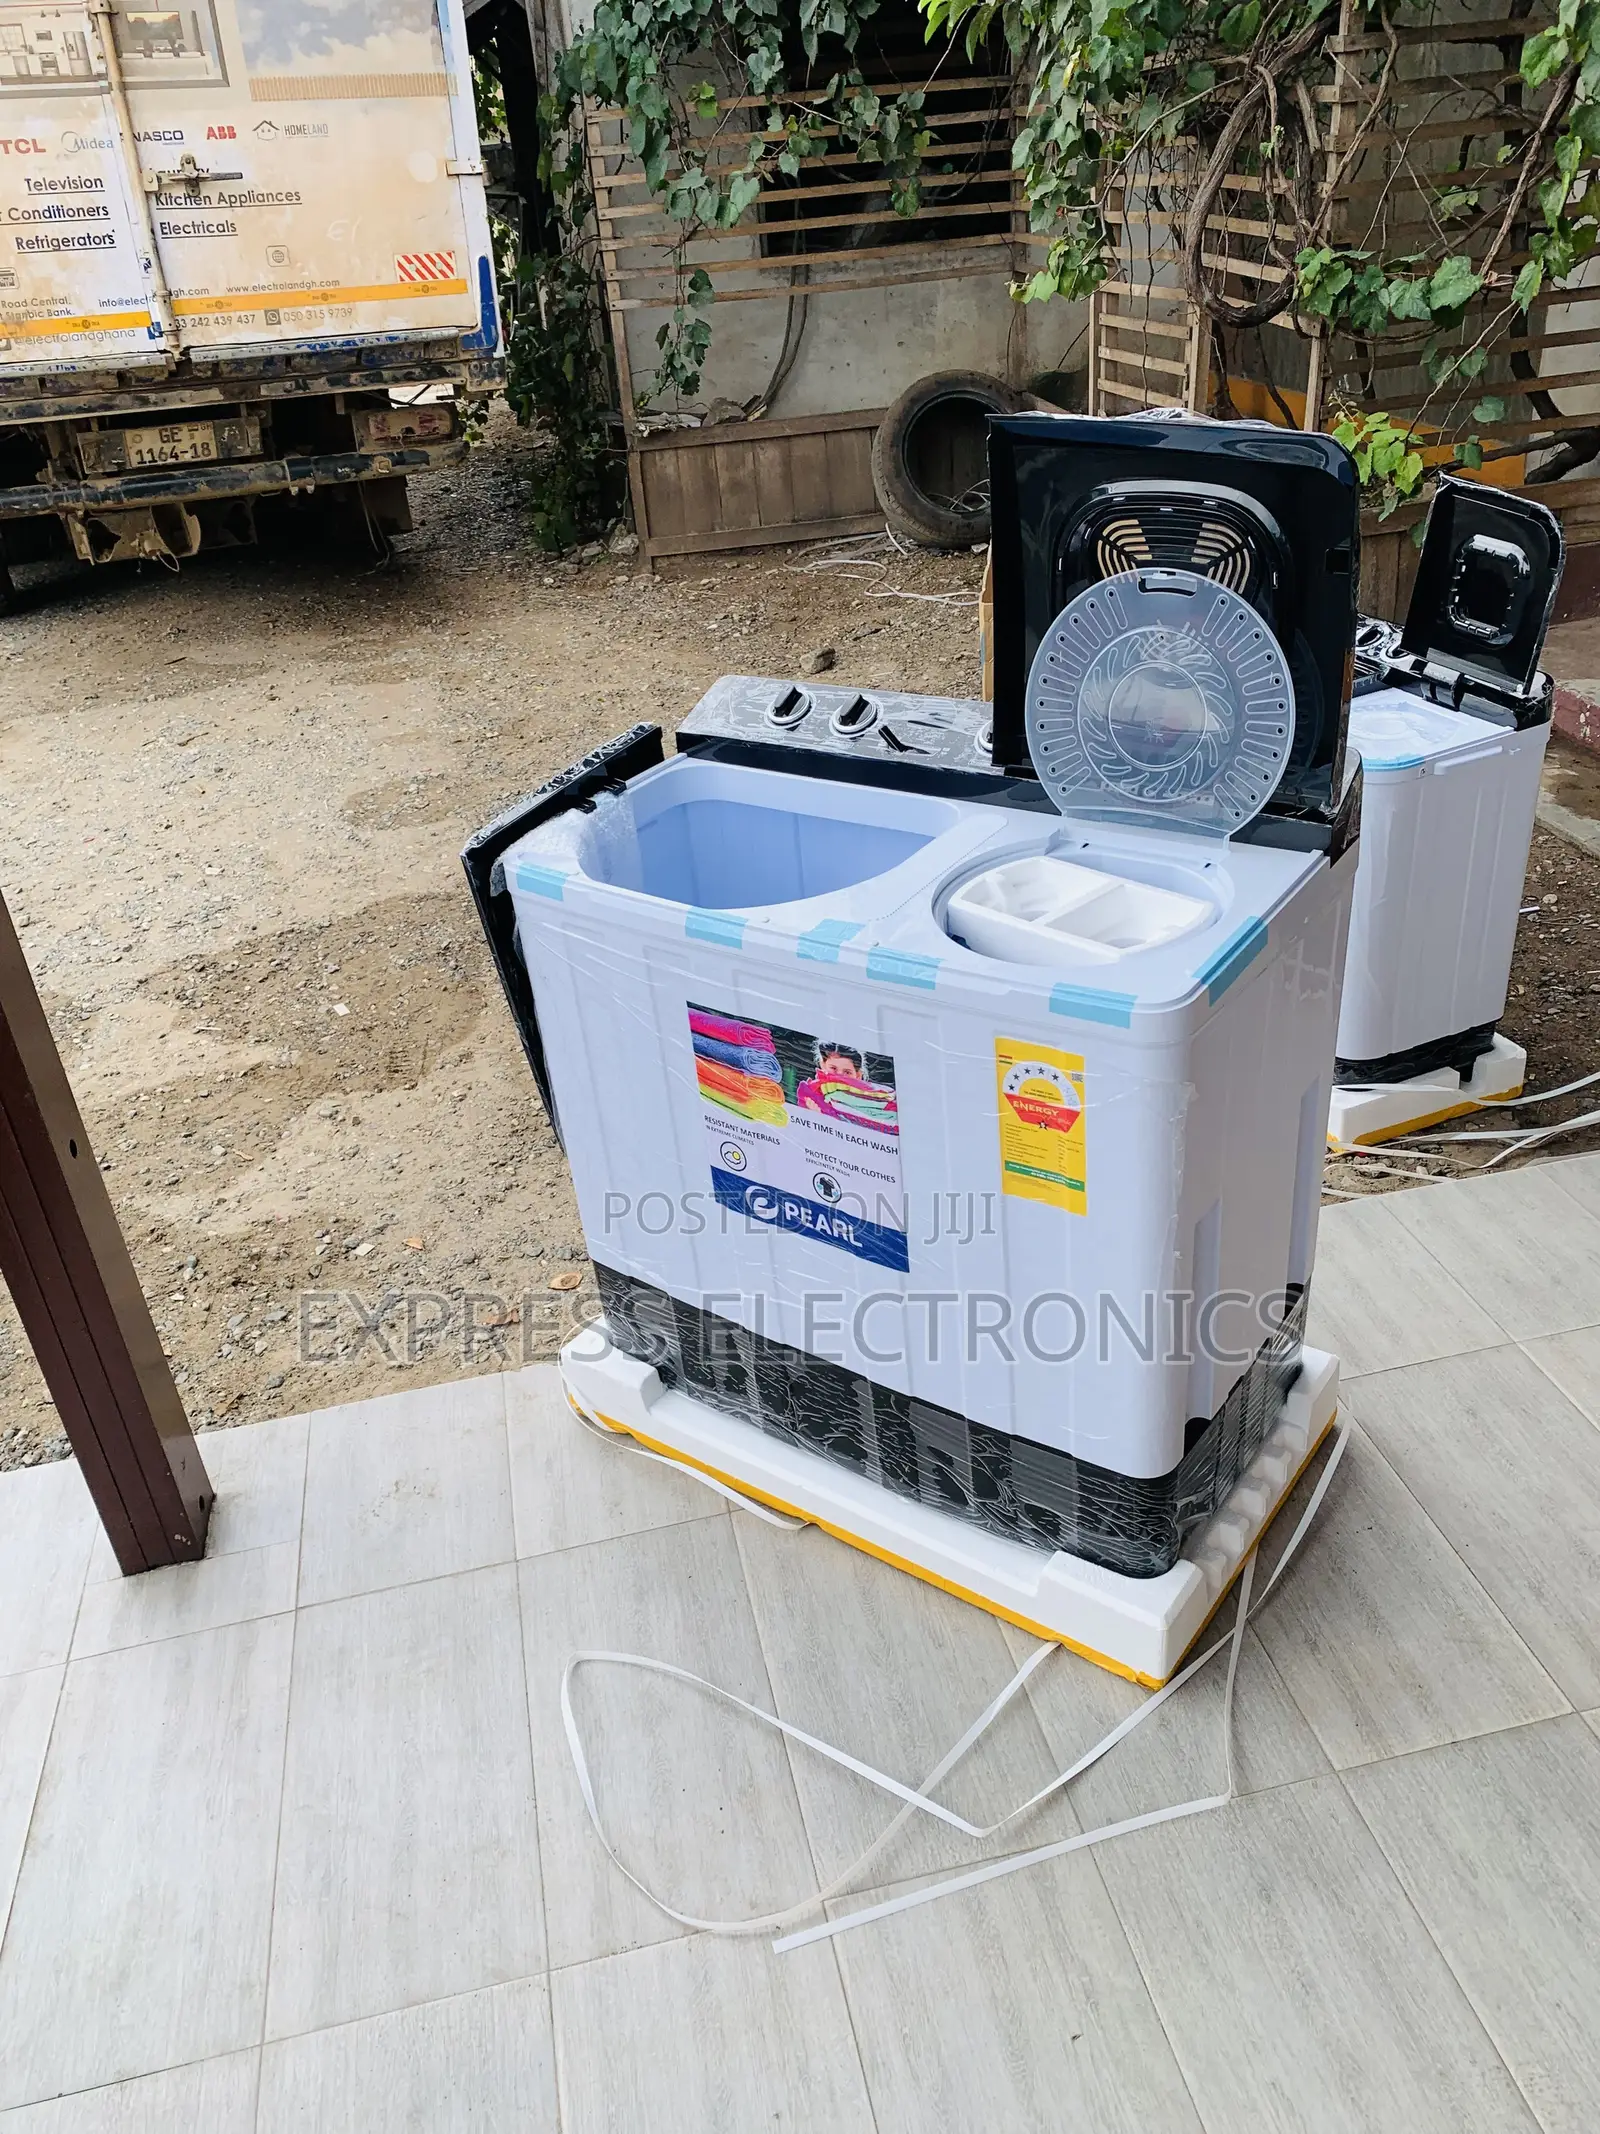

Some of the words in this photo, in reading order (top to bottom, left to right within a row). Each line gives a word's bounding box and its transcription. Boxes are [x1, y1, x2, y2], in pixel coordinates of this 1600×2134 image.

[207, 126, 237, 140] ABB
[284, 123, 329, 136] HOMELAND
[0, 139, 46, 155] TCL
[73, 137, 114, 151] Midea
[24, 175, 104, 192] Television
[155, 191, 212, 206] Kitchen
[217, 189, 301, 207] Appliances
[8, 204, 109, 221] Conditioners
[160, 220, 237, 235] Electricals
[15, 231, 116, 251] Refrigerators
[226, 279, 340, 293] www.electrolandgh.com
[1, 299, 28, 309] Road
[190, 317, 211, 327] 242
[214, 315, 232, 326] 439
[237, 314, 255, 324] 437
[284, 311, 304, 322] 050
[306, 309, 325, 320] 315
[328, 307, 353, 317] 9739
[159, 426, 182, 443] GE
[136, 442, 211, 464] 1164-18
[1013, 1100, 1059, 1116] ENERGY
[704, 1115, 739, 1132] RESISTANT
[740, 1128, 781, 1146] MATERIALS
[790, 1115, 811, 1128] SAVE
[813, 1122, 834, 1135] TIME
[835, 1130, 844, 1140] IN
[845, 1134, 868, 1147] EACH
[870, 1141, 898, 1155] WASH
[804, 1148, 837, 1163] PROTECT
[839, 1160, 860, 1173] YOUR
[861, 1167, 896, 1184] CLOTHES
[784, 1201, 863, 1247] PEARL
